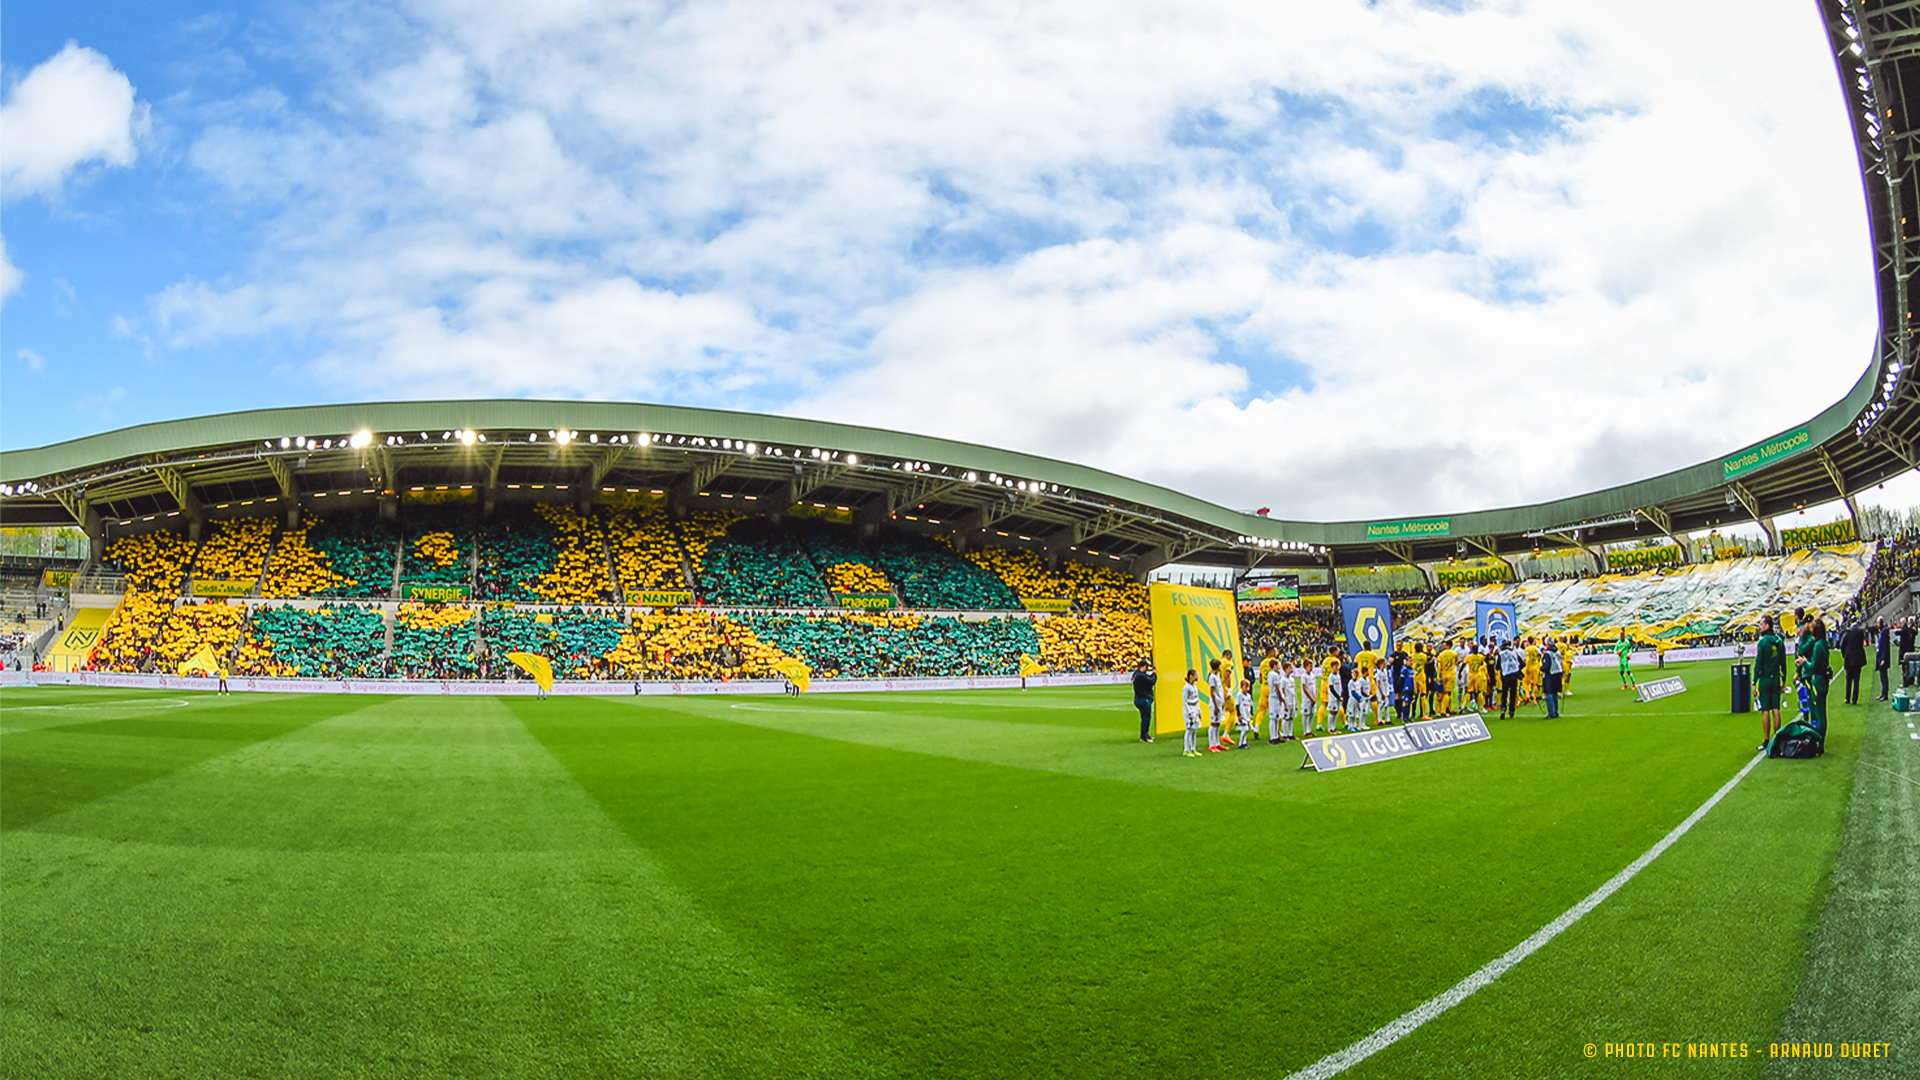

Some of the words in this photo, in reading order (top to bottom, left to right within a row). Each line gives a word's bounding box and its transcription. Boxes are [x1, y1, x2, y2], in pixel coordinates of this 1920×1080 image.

[1724, 453, 1759, 473] Nantes
[1760, 431, 1809, 459] Métropole
[1367, 525, 1400, 535] Nantes
[1402, 520, 1449, 534] Métropole
[411, 587, 463, 600] SYNERGIE
[626, 593, 640, 603] FC
[841, 597, 890, 609] macron
[1171, 592, 1188, 606] FC
[1188, 594, 1226, 610] NANTES
[353, 683, 377, 693] Soigner
[386, 683, 410, 693] prendre
[453, 684, 477, 694] Soigner
[486, 684, 511, 694] prendre
[555, 684, 579, 694] Soigner
[588, 684, 613, 694] prendre
[1351, 731, 1412, 759] LIGUE
[1410, 728, 1422, 747] 1
[1421, 726, 1454, 746] Uber
[1450, 721, 1481, 740] Eats
